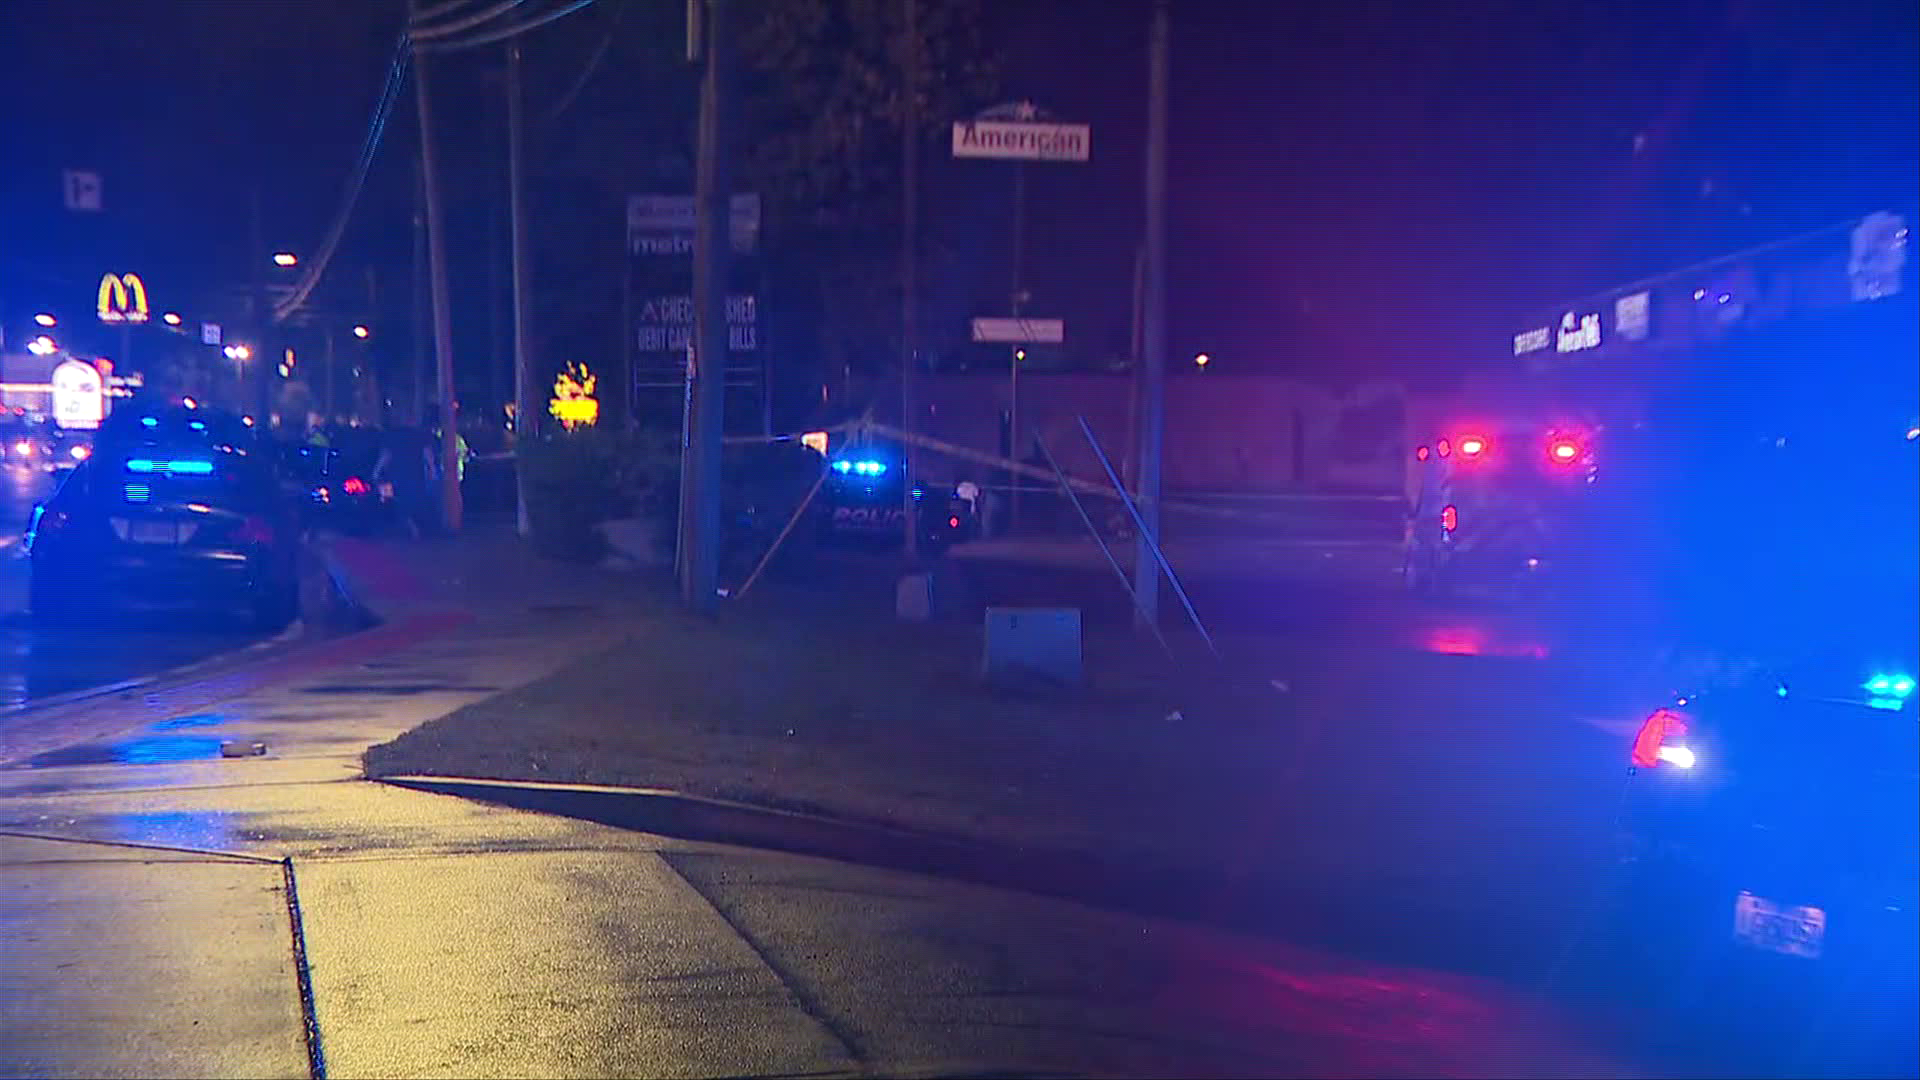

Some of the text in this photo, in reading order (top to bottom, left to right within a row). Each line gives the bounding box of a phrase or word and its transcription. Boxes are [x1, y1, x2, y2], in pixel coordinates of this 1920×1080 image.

[962, 121, 1081, 152] American
[660, 295, 695, 323] CHEC
[725, 295, 756, 323] SHED
[729, 326, 756, 351] BILLS
[833, 506, 905, 523] POLIC
